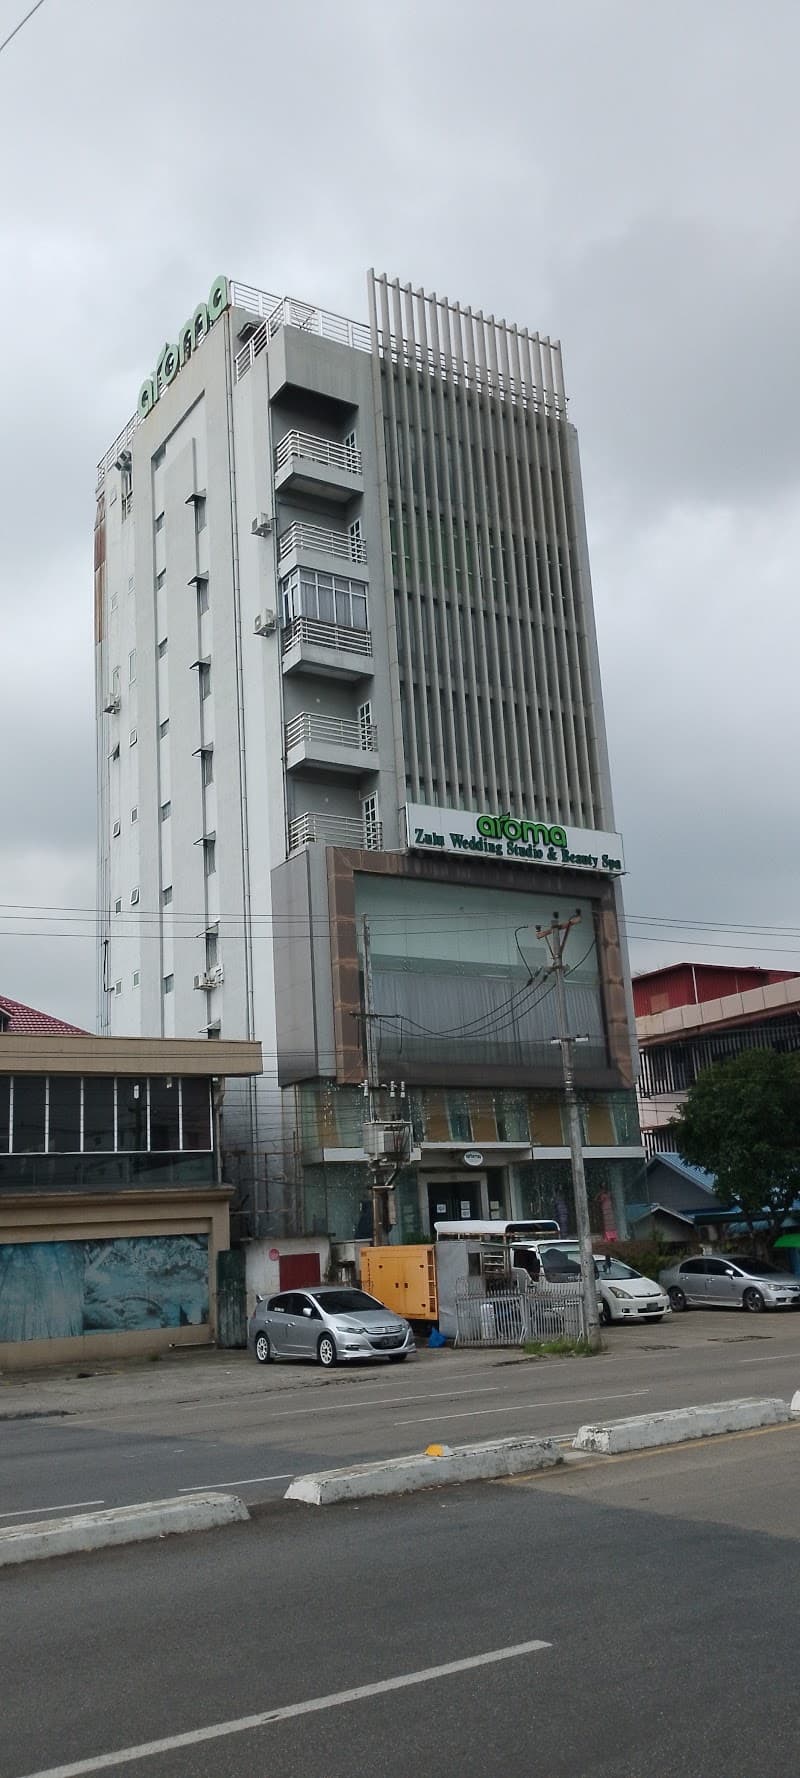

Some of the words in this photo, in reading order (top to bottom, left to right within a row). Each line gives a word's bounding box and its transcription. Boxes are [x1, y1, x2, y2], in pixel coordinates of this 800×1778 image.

[137, 275, 228, 418] aroma
[477, 812, 567, 848] aroma
[449, 833, 503, 856] Wedding
[507, 841, 543, 859] Studio
[547, 847, 558, 861] &
[560, 848, 598, 868] Beauty
[602, 854, 621, 870] Spa
